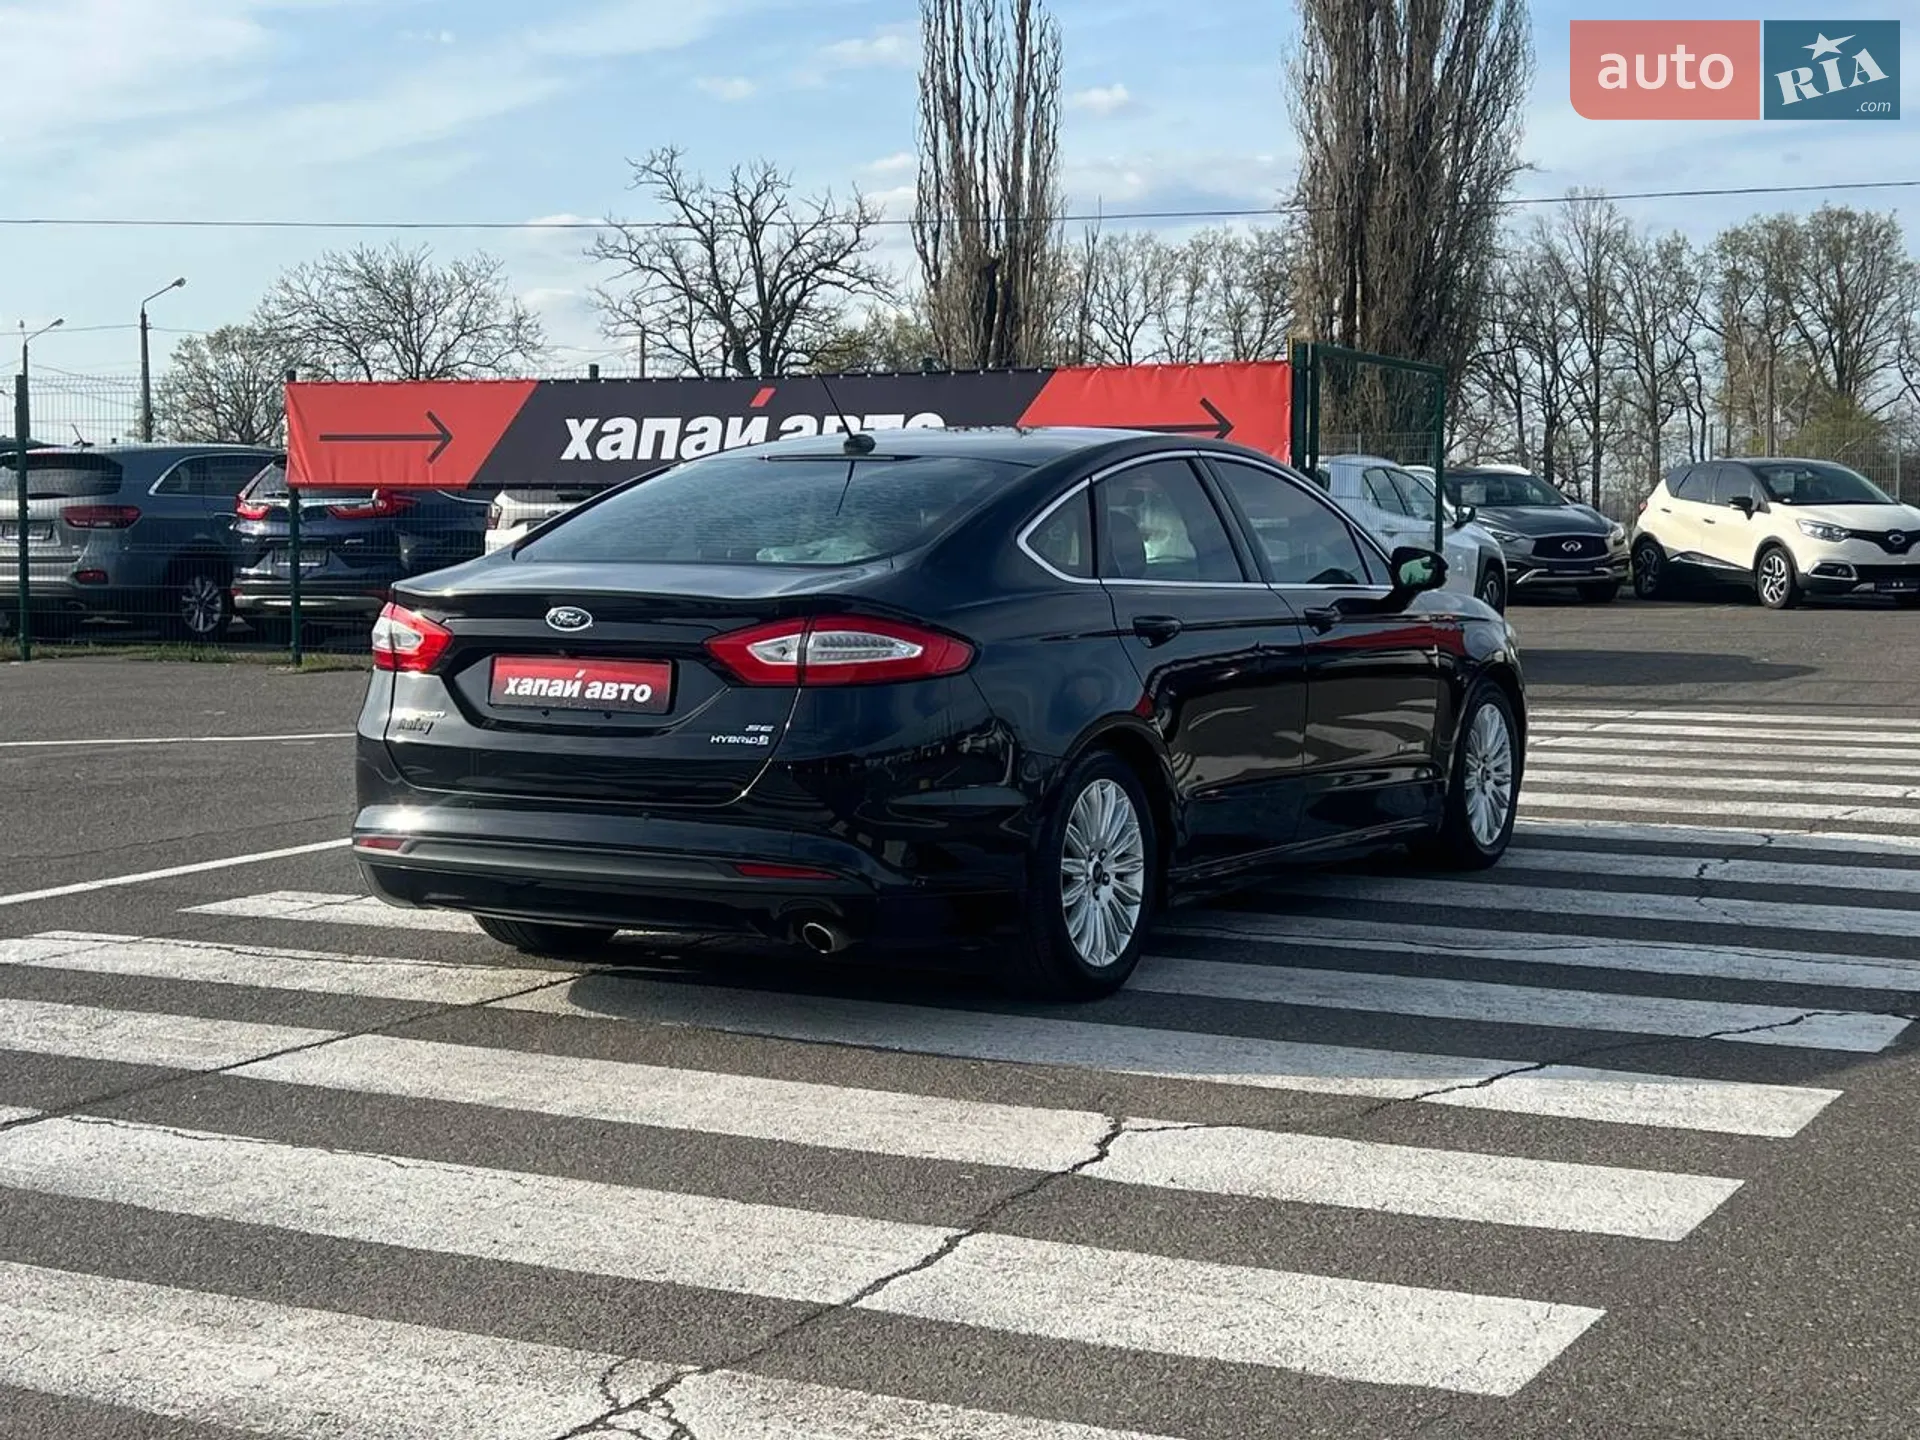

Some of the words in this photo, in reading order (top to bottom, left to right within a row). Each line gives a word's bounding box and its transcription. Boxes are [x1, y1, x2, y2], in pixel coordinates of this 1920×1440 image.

[560, 387, 776, 460] хапай
[504, 669, 587, 698] хапай
[585, 680, 652, 703] авто
